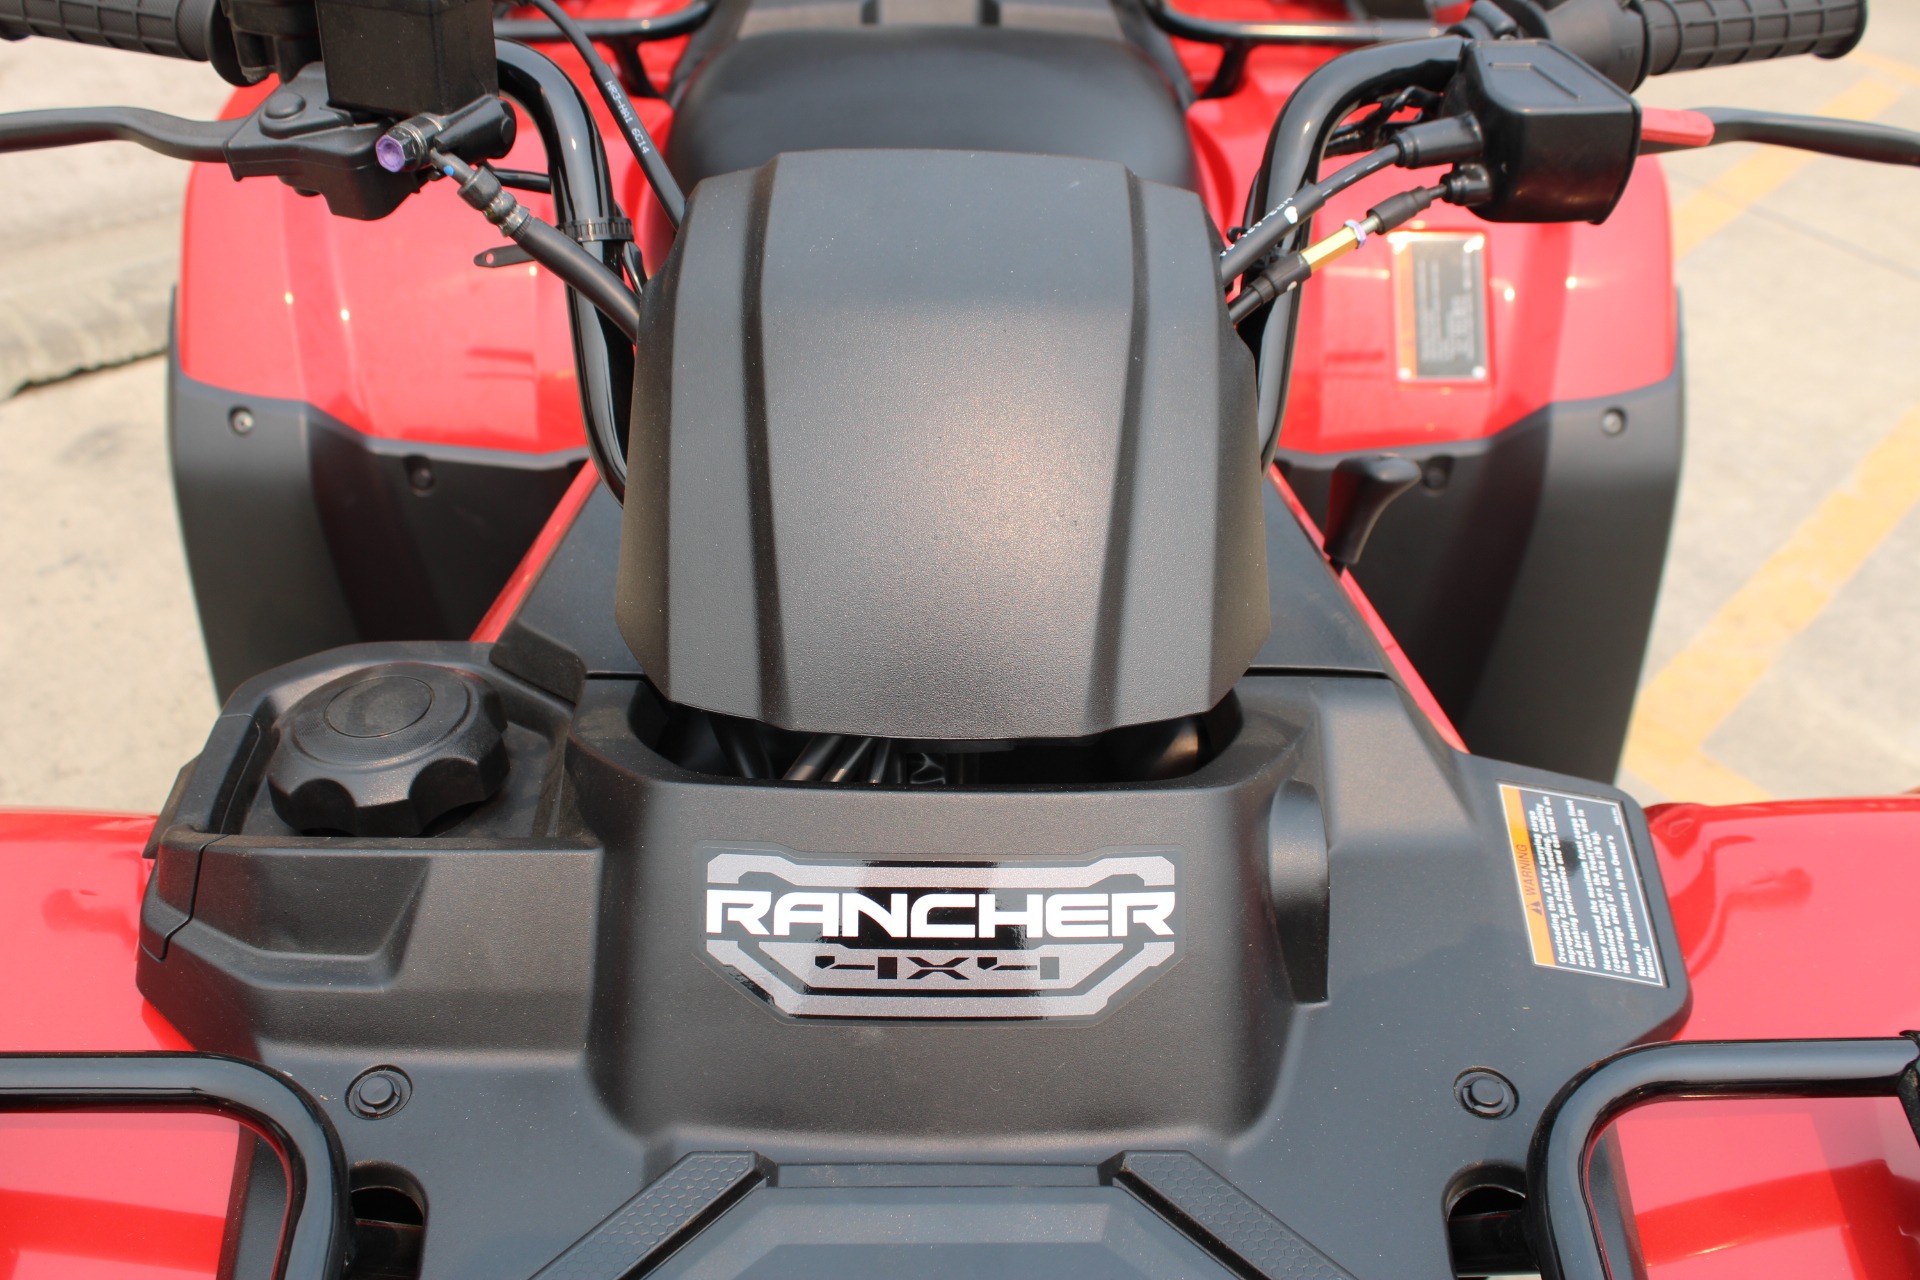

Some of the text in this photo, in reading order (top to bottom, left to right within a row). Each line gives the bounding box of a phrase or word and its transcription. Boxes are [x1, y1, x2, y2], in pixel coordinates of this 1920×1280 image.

[631, 127, 650, 153] 6C14
[1534, 802, 1549, 834] stability
[1604, 834, 1621, 866] Owner's
[1516, 843, 1536, 896] WARNING
[1542, 795, 1586, 966] and braking performance and can lead to an
[1596, 859, 1608, 875] Lbs
[1600, 875, 1611, 886] 66
[1613, 866, 1624, 880] the
[1527, 809, 1568, 963] Overloading this ATV or carrying cargo
[1550, 872, 1564, 901] change
[1564, 799, 1612, 970] Never exceed the maximum front cargo limit
[1576, 808, 1623, 972] (combined weight on the front rack and in
[1604, 892, 1615, 902] of
[1616, 881, 1627, 890] in
[706, 889, 1175, 938] RANCHER
[1557, 902, 1566, 918] can
[1607, 902, 1621, 924] area)
[1559, 919, 1578, 964] improperly
[1580, 929, 1596, 968] accident.
[1613, 925, 1629, 958] storage
[1631, 941, 1641, 952] to
[1620, 959, 1631, 973] the
[1633, 952, 1647, 976] Refer
[1640, 944, 1656, 978] Manual.
